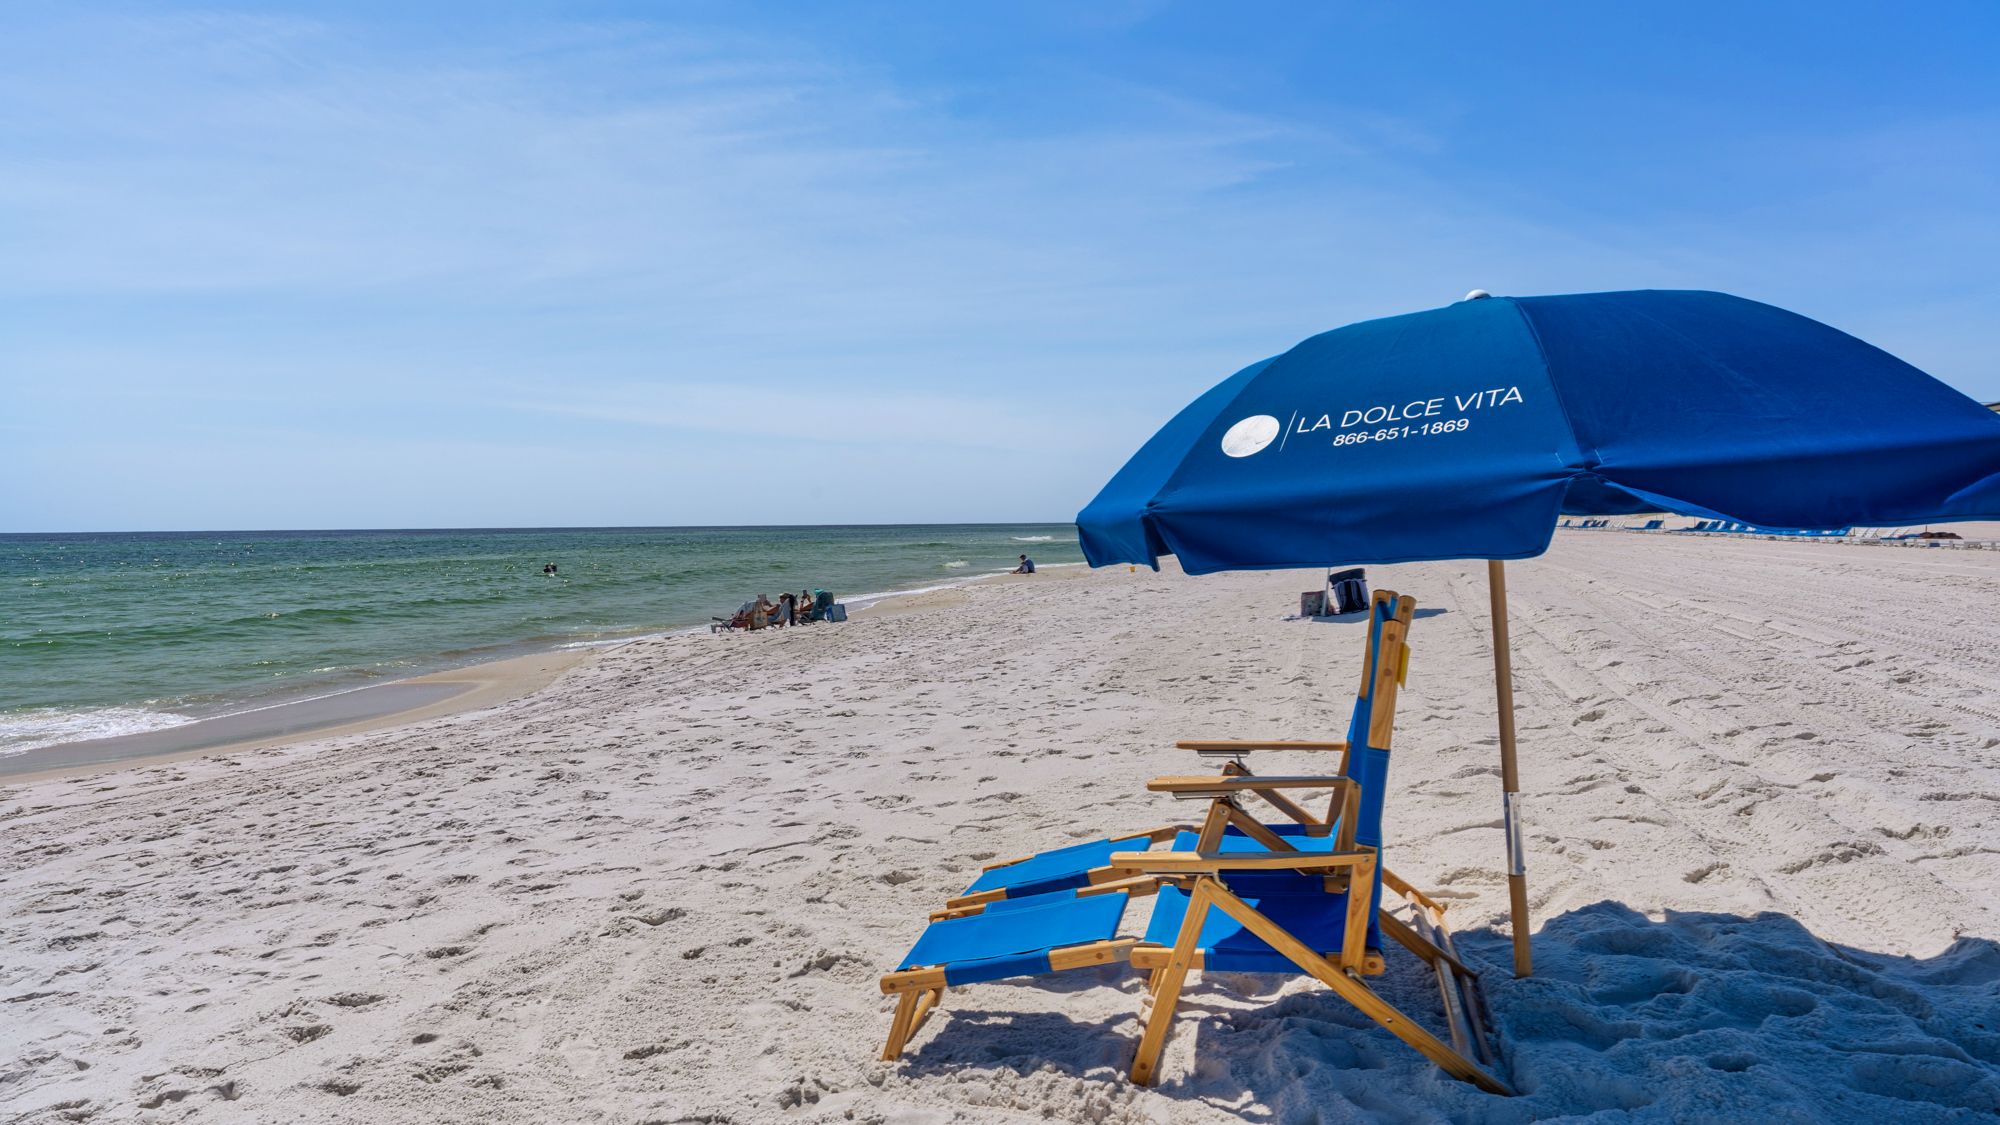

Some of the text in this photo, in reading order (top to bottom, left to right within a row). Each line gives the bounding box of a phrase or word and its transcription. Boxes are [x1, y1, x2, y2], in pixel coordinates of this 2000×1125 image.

[1296, 386, 1524, 434] LA DOLCE VITA
[1332, 418, 1470, 447] 866-651-1869
